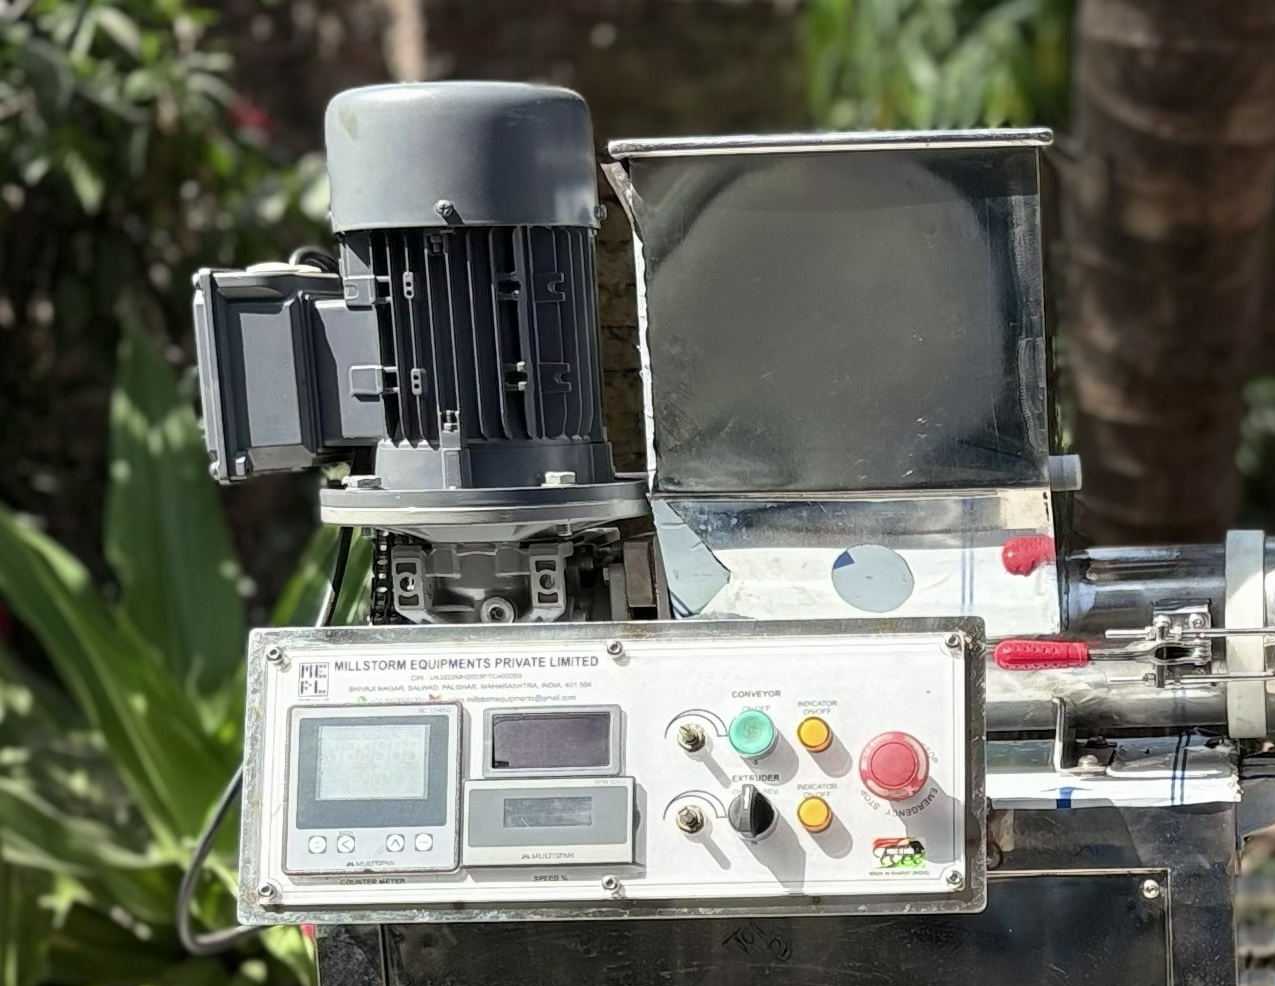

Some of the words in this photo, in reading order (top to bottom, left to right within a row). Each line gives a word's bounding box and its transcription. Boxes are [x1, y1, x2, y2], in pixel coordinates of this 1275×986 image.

[334, 660, 407, 672] MILLSTORM
[410, 658, 491, 671] EQUIPMENTS
[494, 657, 547, 669] PRIVATE
[549, 656, 599, 668] LIMITED
[731, 690, 781, 698] CONVEYOR
[731, 774, 780, 782] EXTRUDER
[860, 788, 881, 811] STOP
[885, 787, 939, 818] EMERGENCY
[531, 852, 575, 860] MULTISPAN
